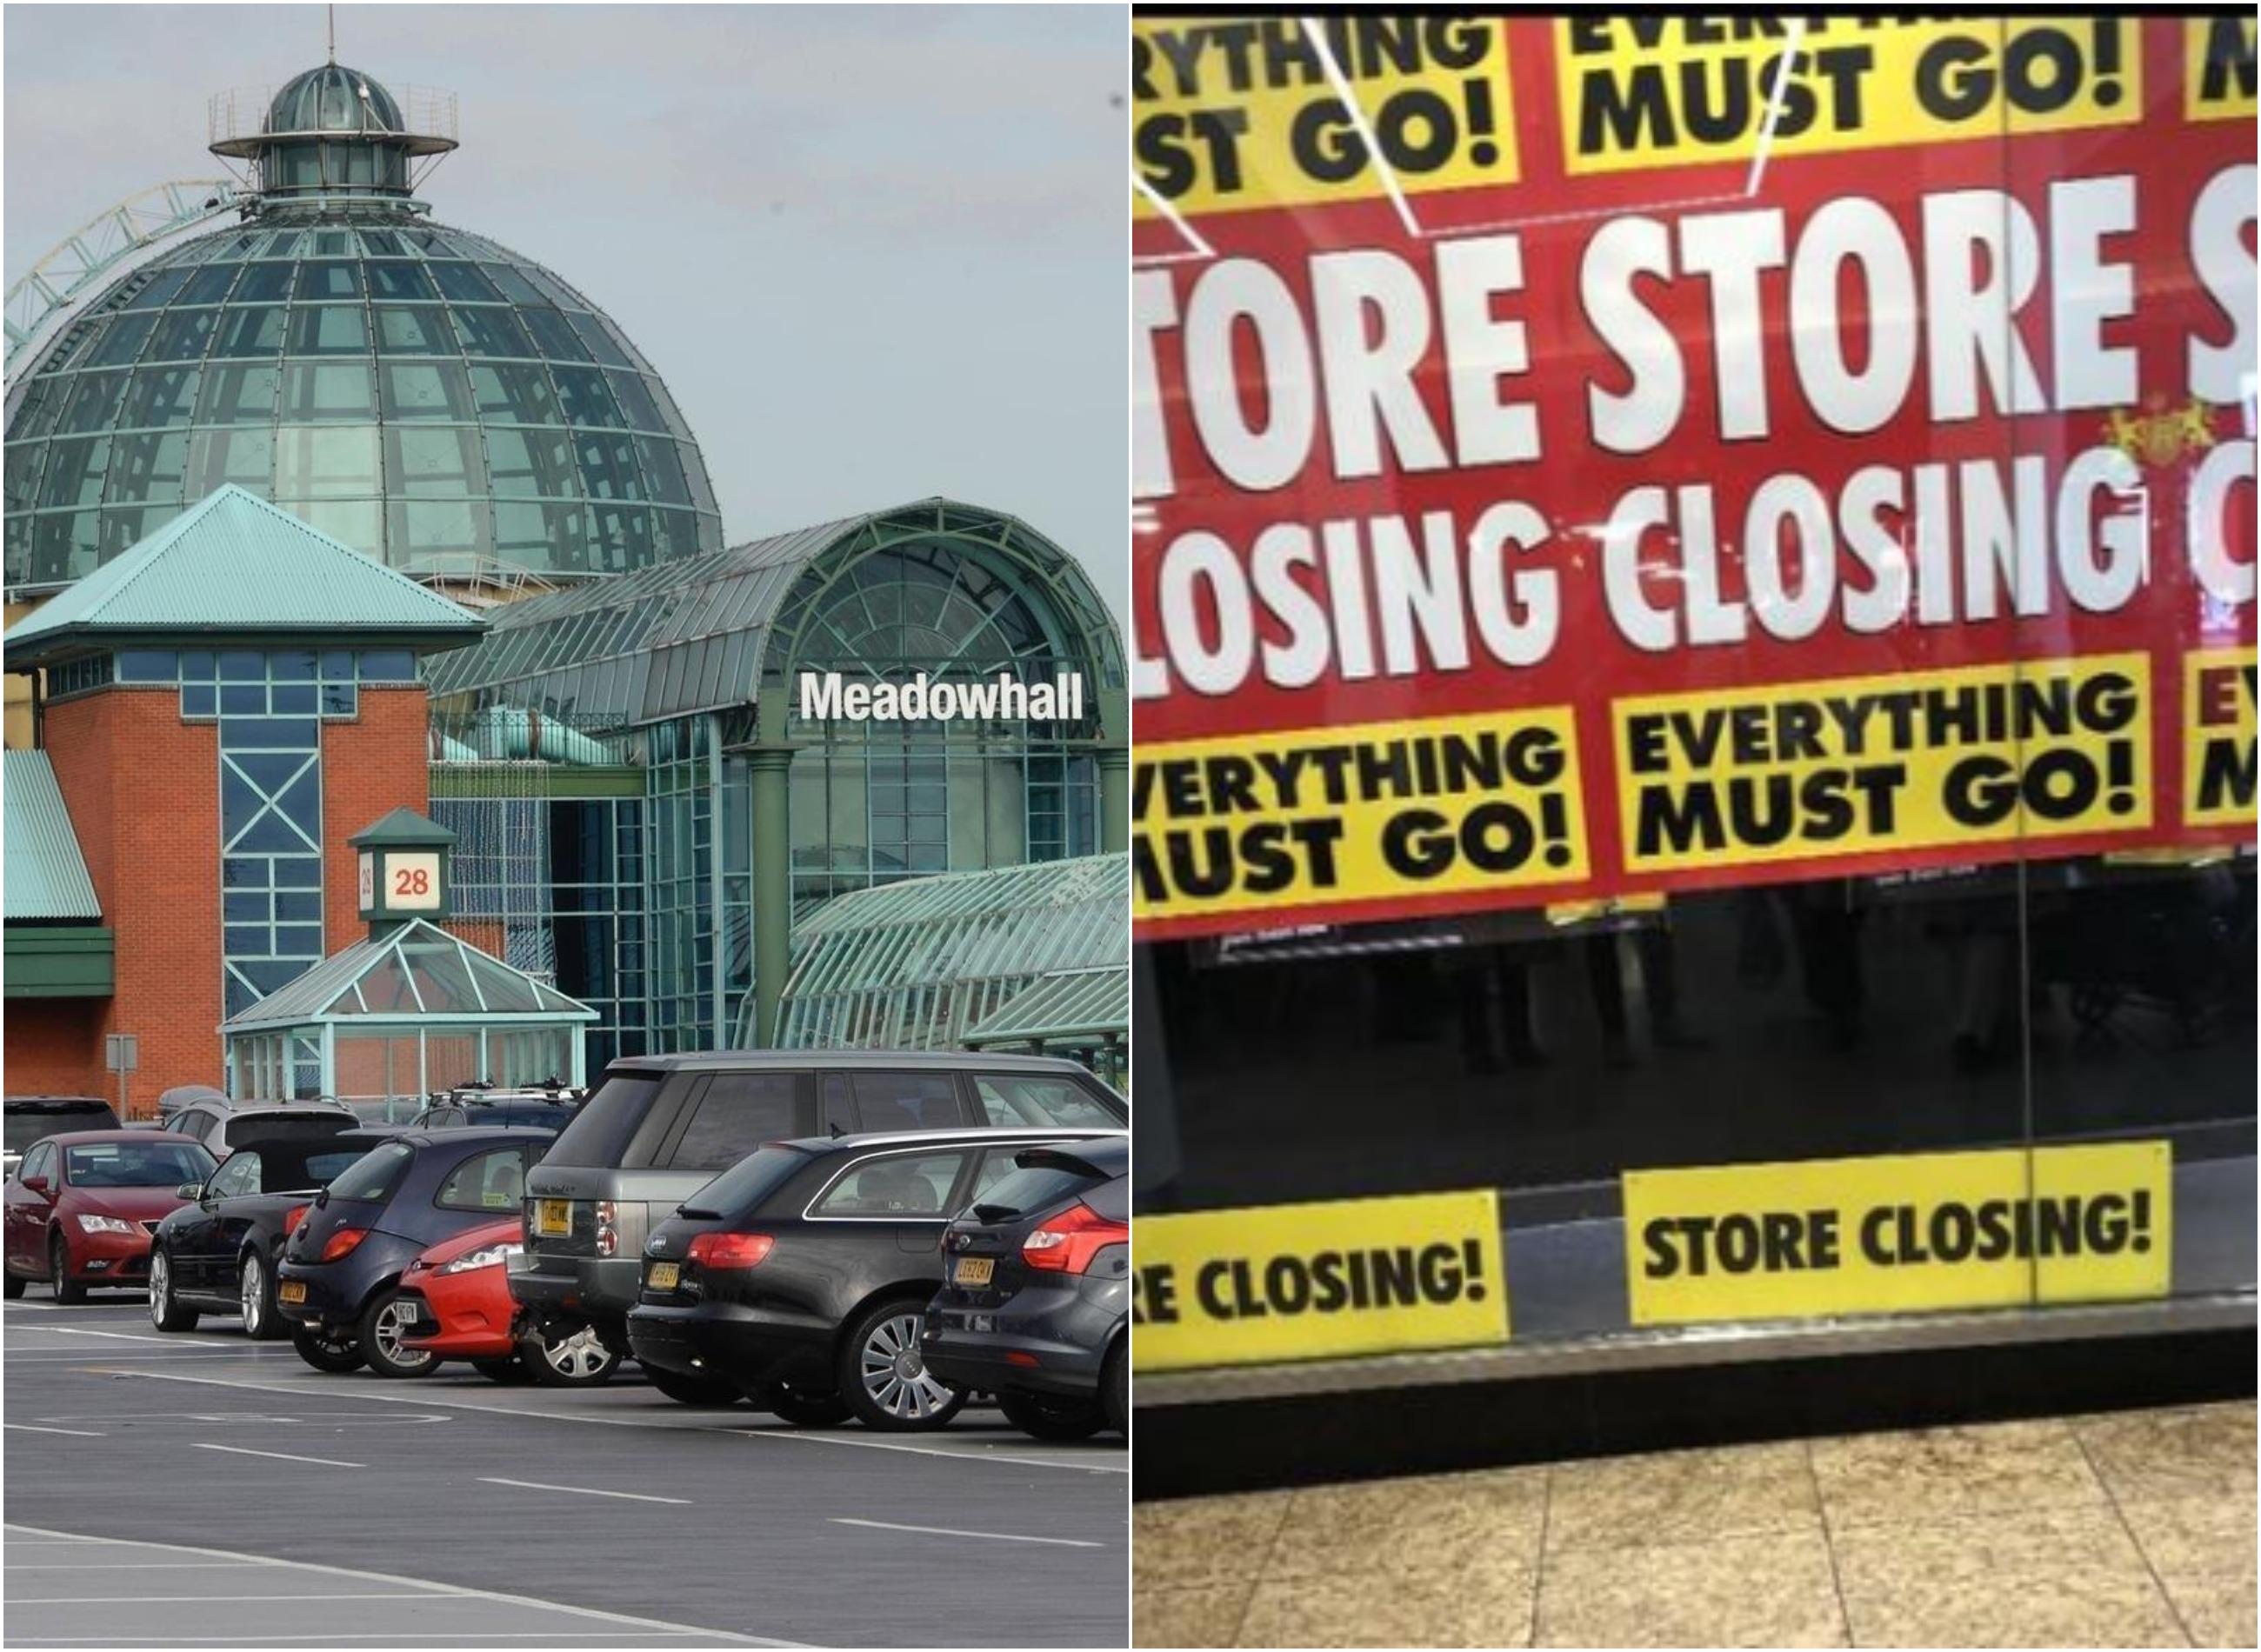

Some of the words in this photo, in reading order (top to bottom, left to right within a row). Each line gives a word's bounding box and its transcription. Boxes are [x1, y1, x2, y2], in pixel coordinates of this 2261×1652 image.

[1290, 80, 1500, 183] GO!
[1577, 44, 1874, 156] MUST
[1914, 17, 2124, 122] GO!
[1579, 174, 2140, 453] STORE
[1603, 445, 2144, 652] CLOSING
[800, 672, 1083, 721] Meadowhall
[1626, 672, 2138, 775] EVERYTHING
[1382, 792, 1573, 880] GO!
[1634, 762, 1910, 856] MUST
[1942, 738, 2136, 828] GO!
[395, 869, 430, 896] 28
[1195, 1237, 1487, 1322] CLOSING!
[1643, 1209, 1842, 1280] STORE
[1860, 1189, 2152, 1267] CLOSING!
